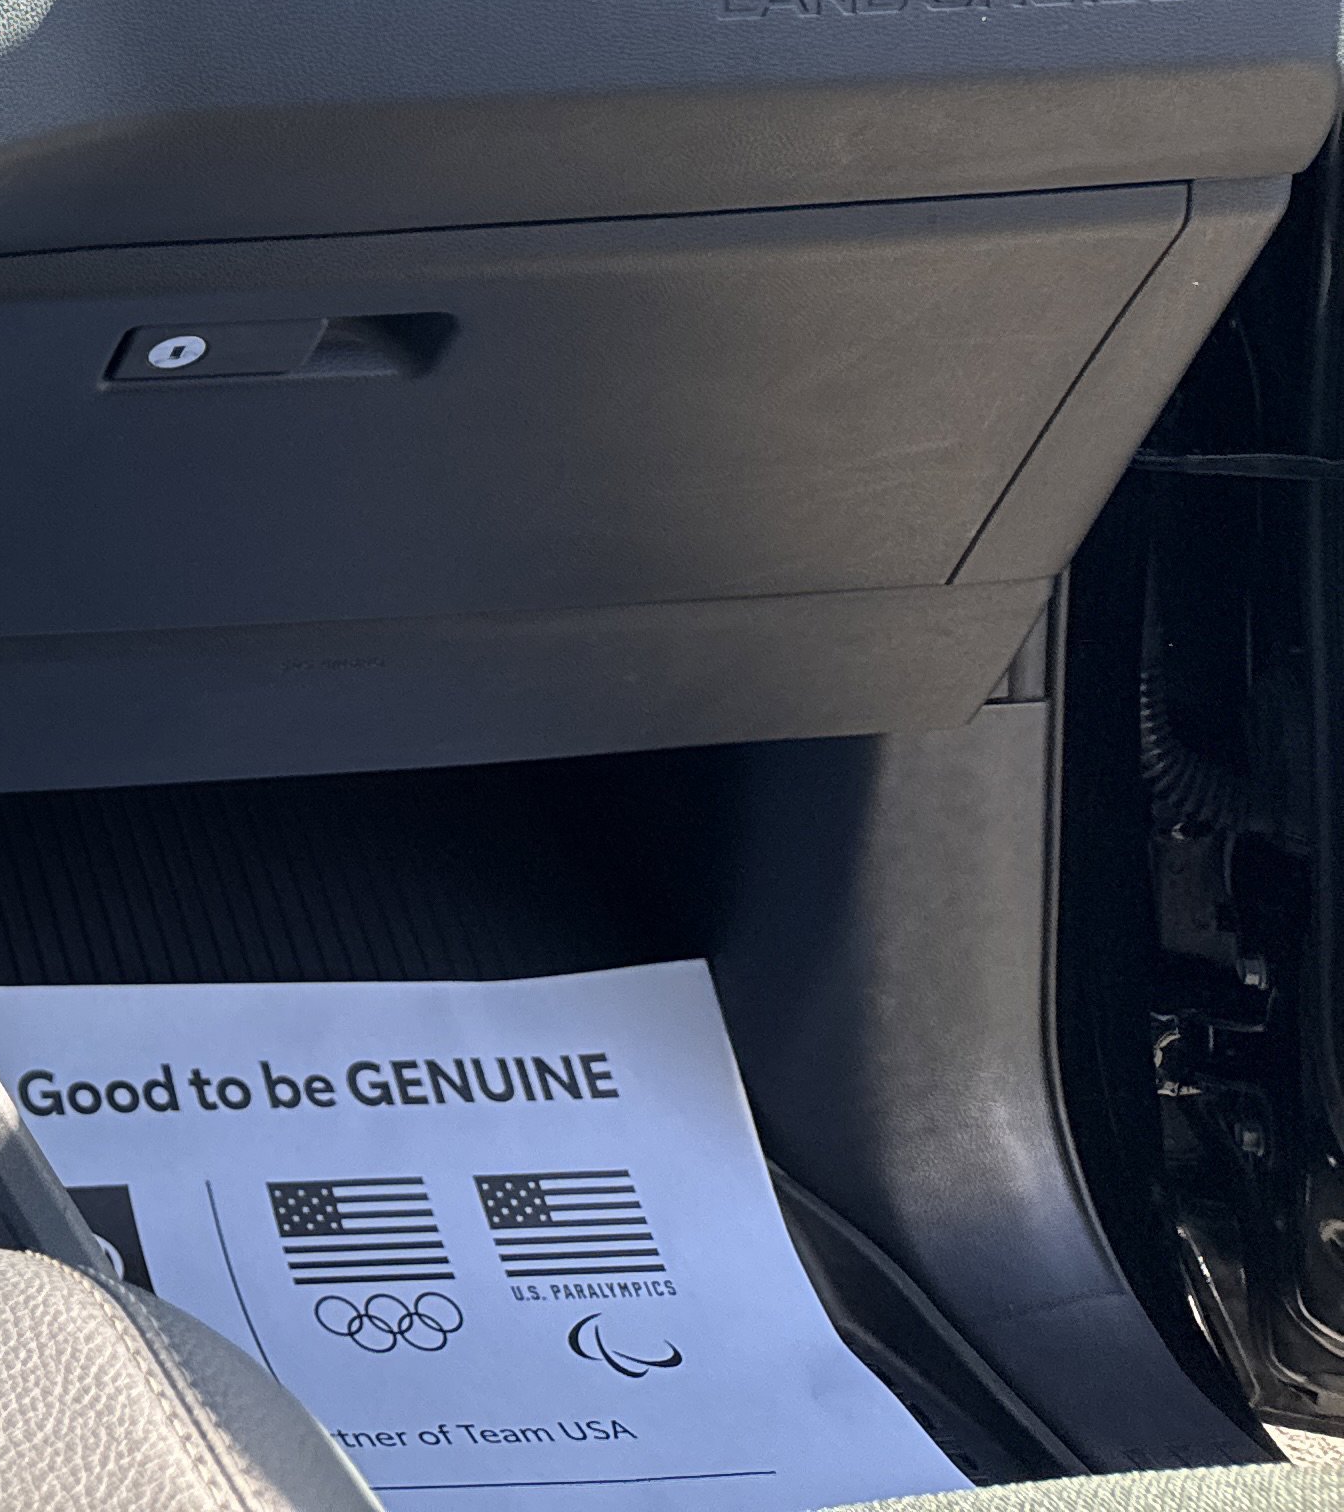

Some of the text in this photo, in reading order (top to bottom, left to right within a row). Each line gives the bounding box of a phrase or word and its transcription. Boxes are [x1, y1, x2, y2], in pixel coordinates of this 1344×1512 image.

[17, 1052, 620, 1117] Good to be GENUINE
[511, 1279, 677, 1301] U.S. PARALYMPICS
[330, 1420, 638, 1448] tner of Team USA
